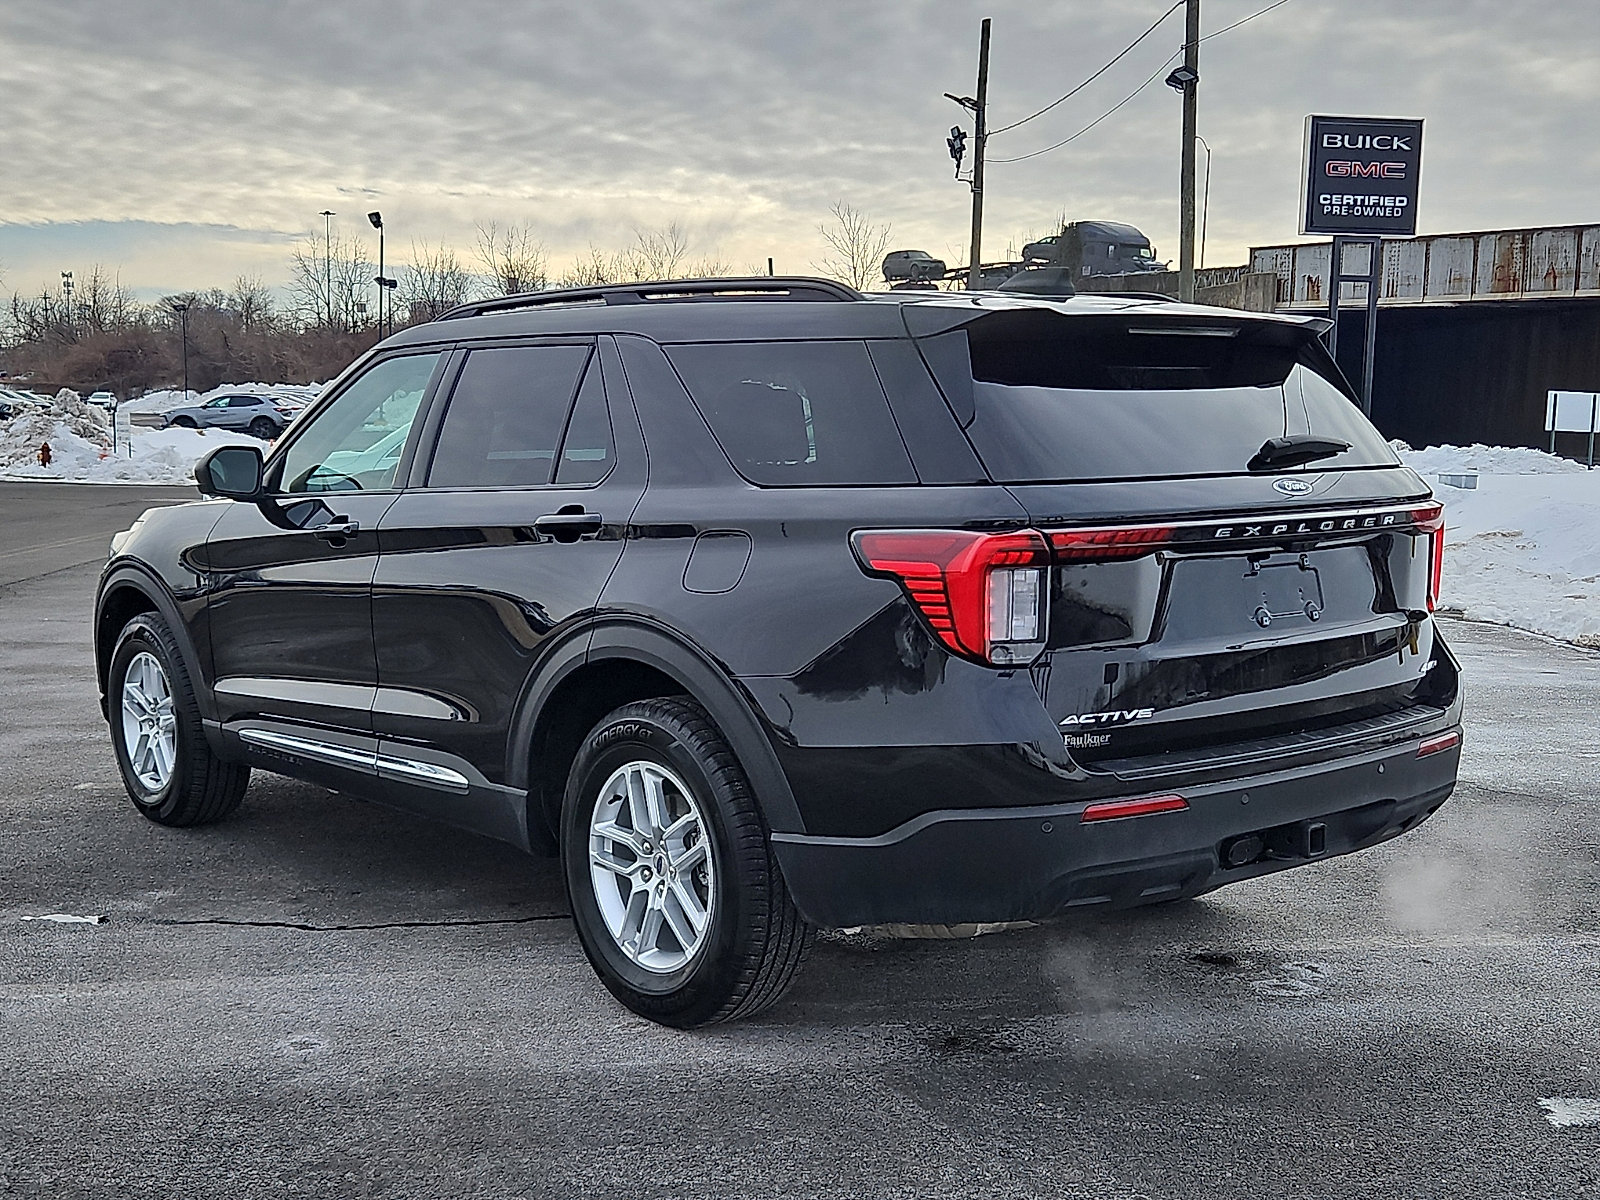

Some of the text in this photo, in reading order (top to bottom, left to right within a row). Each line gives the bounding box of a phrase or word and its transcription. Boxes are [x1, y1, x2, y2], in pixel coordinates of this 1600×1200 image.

[1322, 134, 1412, 150] BUICK
[1326, 160, 1406, 179] GMC
[1319, 194, 1408, 207] CERTIFIED
[1323, 205, 1402, 217] PRE-OWNED
[1215, 515, 1396, 538] EXPLORER
[1059, 708, 1155, 726] ACTIVE
[1064, 733, 1112, 746] Faulkner
